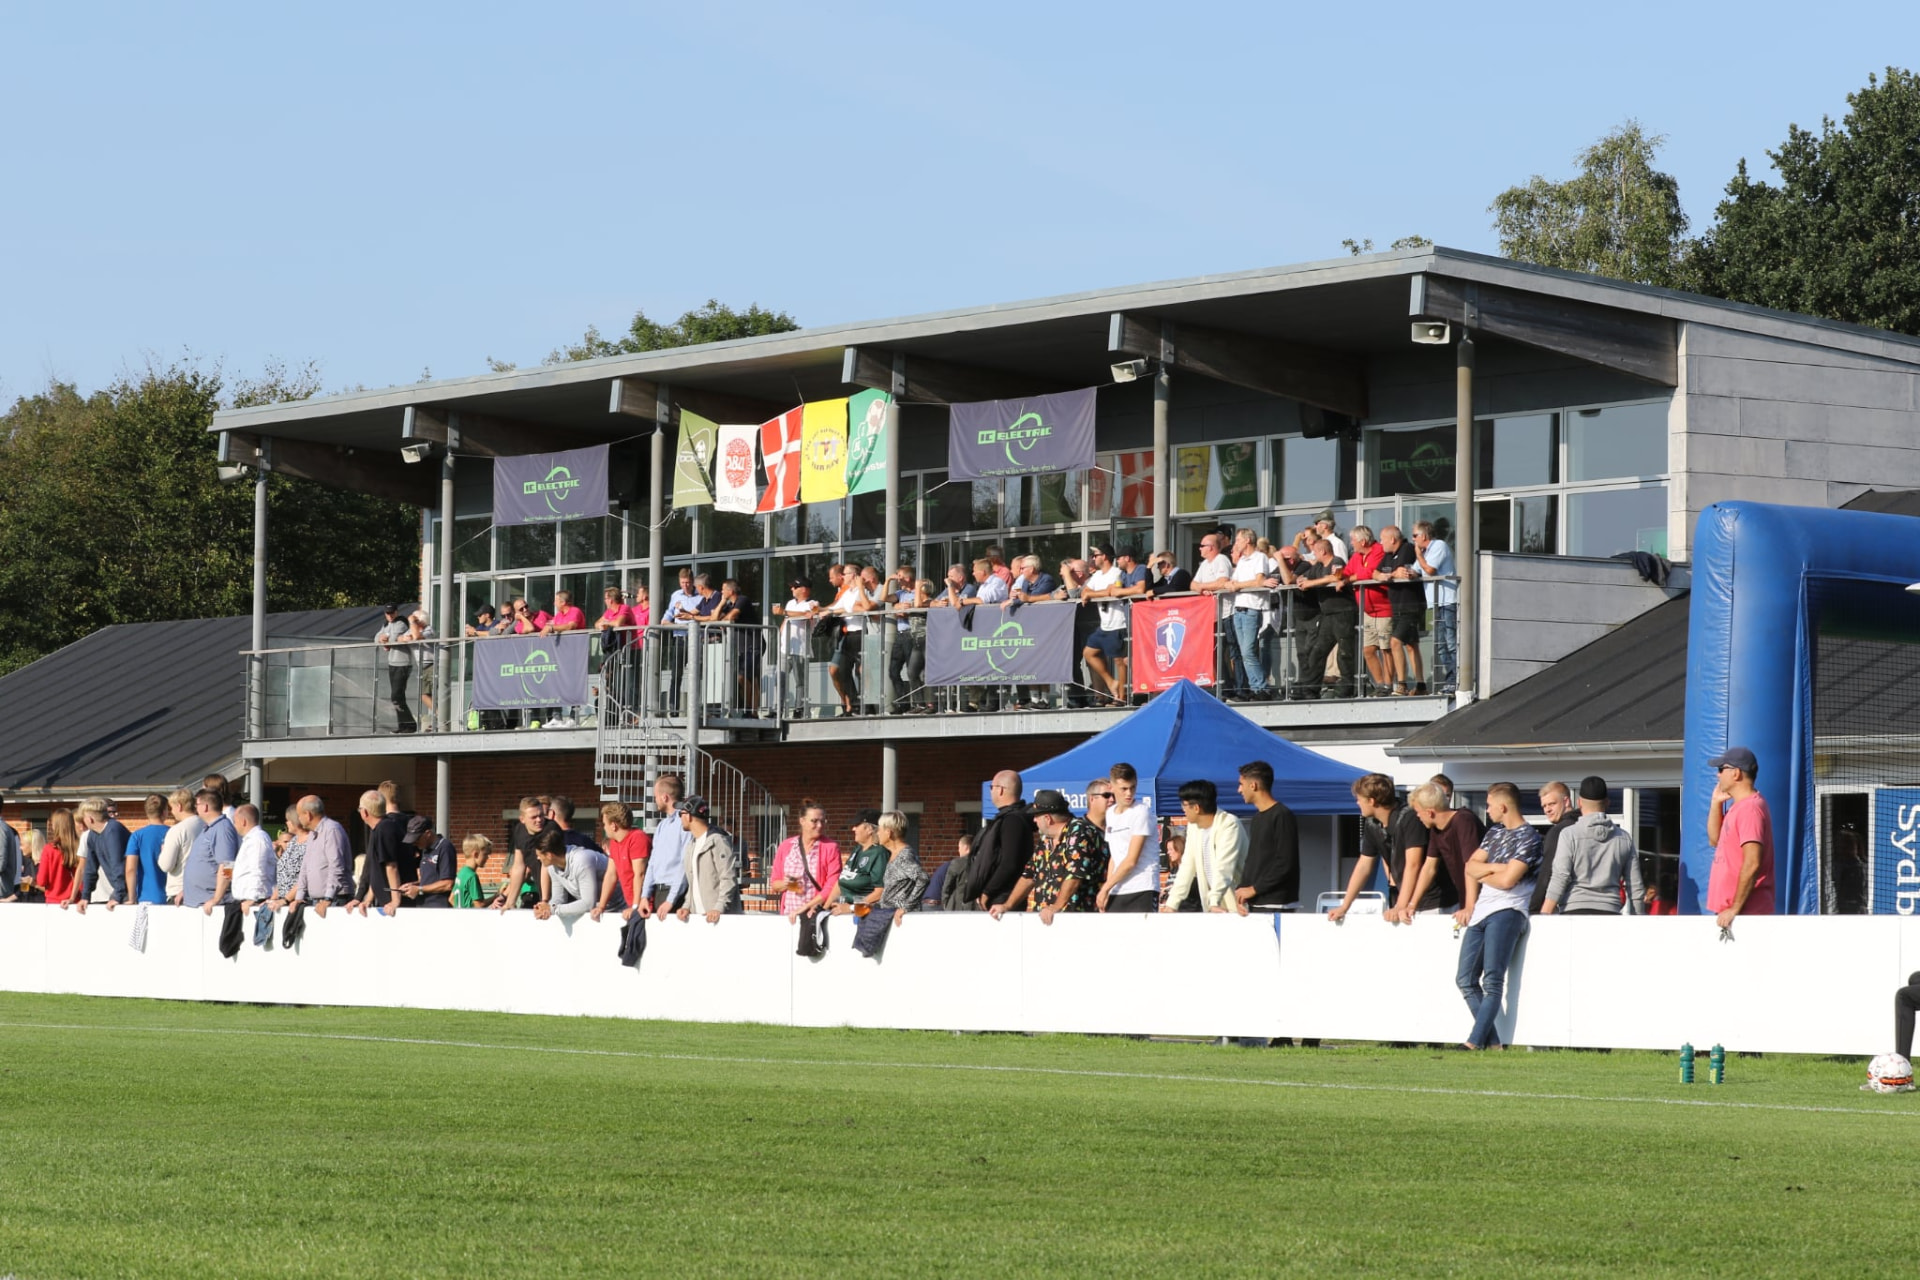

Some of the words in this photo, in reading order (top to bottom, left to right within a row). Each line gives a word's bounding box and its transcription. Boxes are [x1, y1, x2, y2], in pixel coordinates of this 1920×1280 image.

[997, 427, 1053, 441] ELECTRIC
[538, 479, 580, 491] ELECTRIC
[979, 637, 1035, 648] ELECTRIC
[515, 664, 558, 674] ELECTRIC
